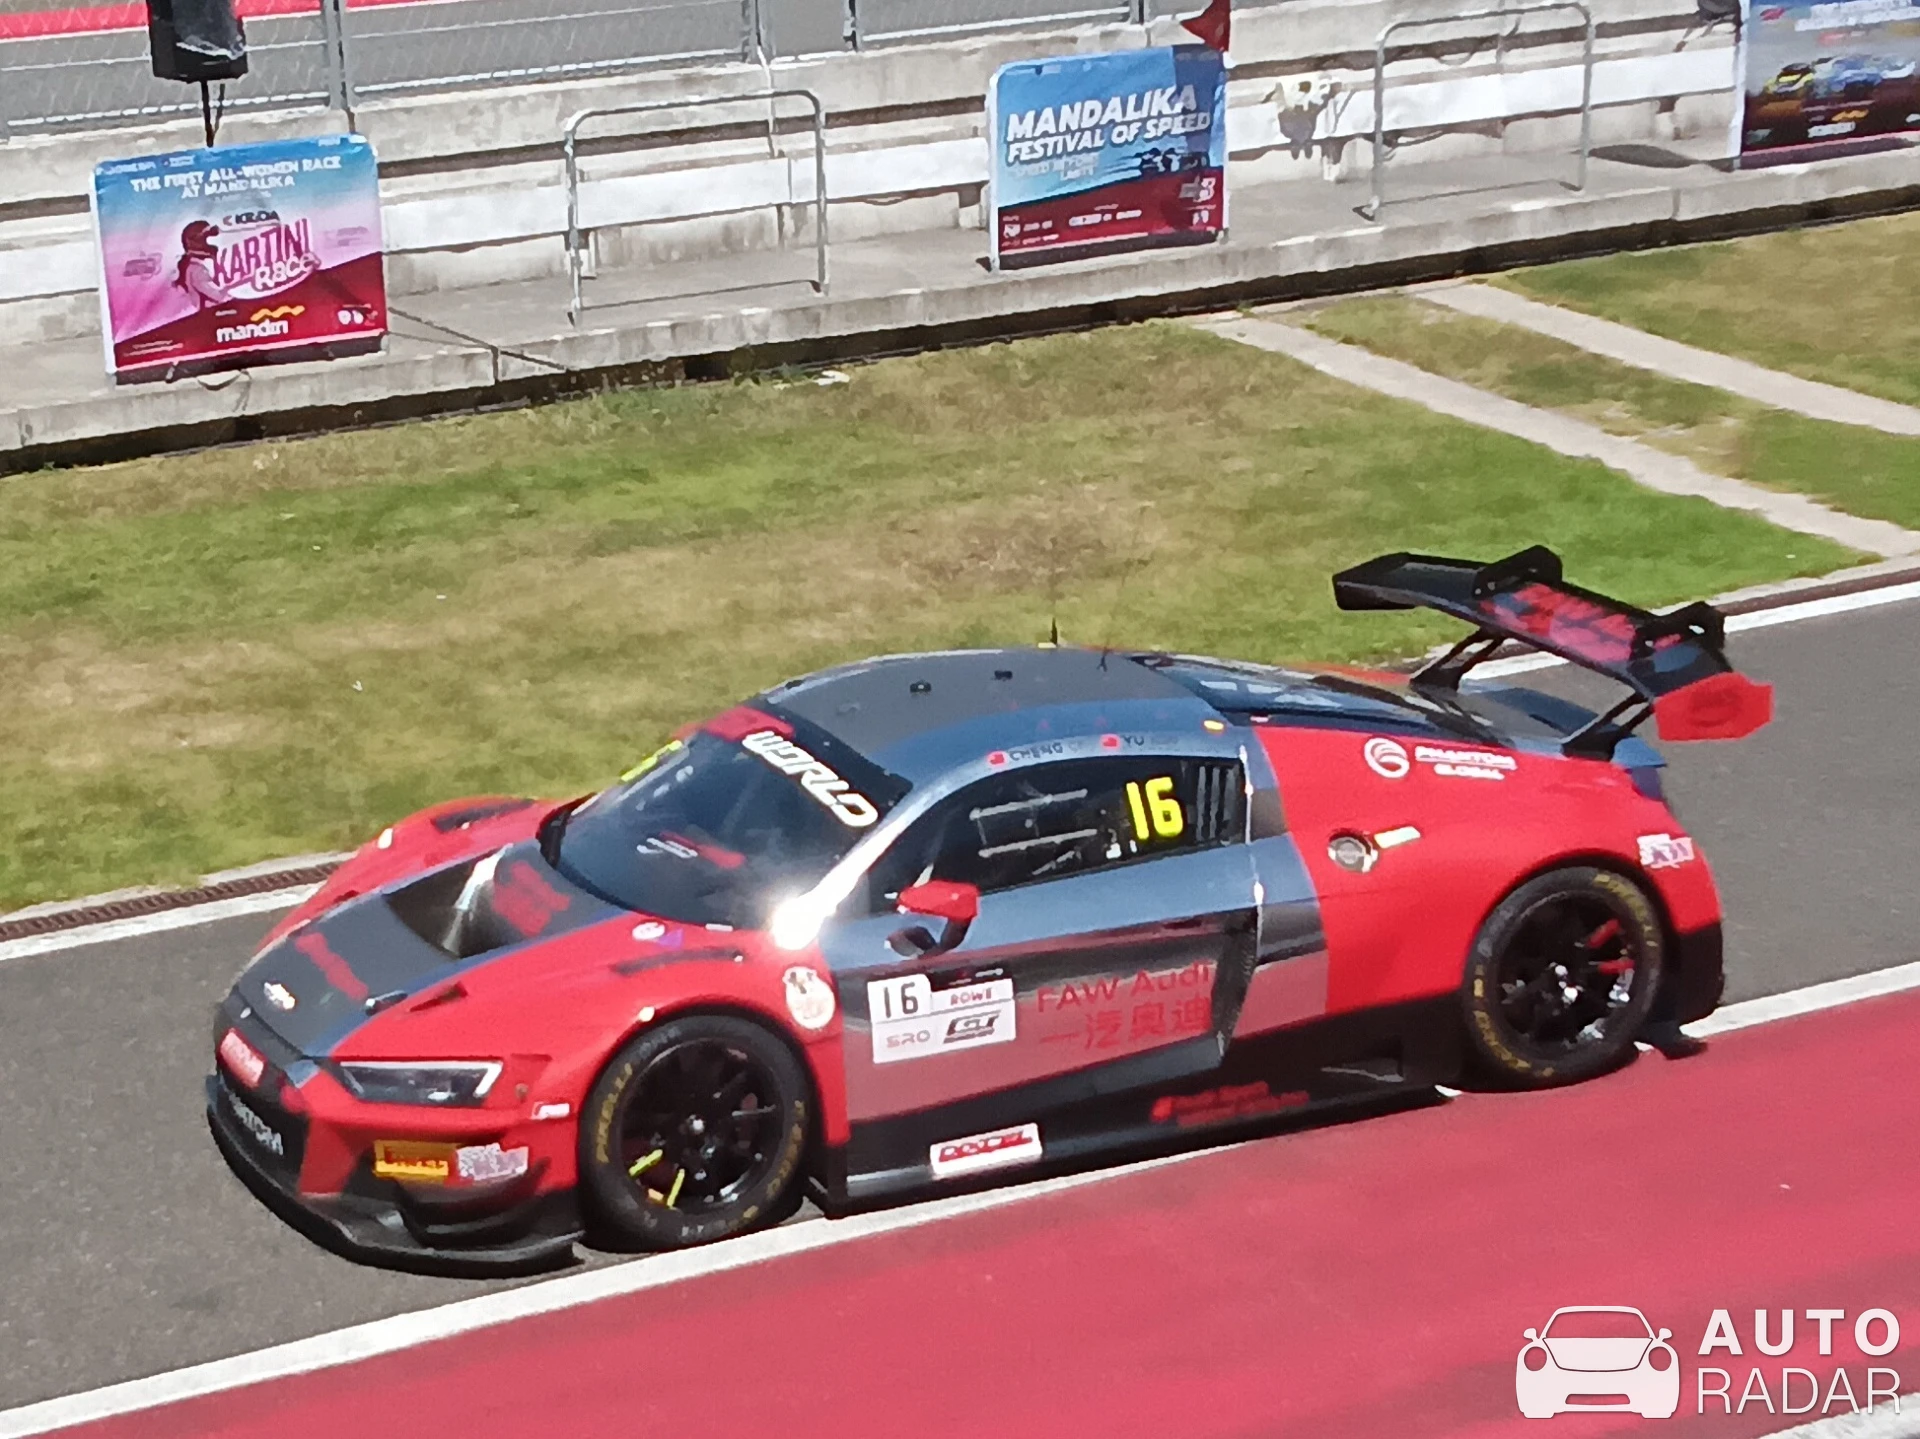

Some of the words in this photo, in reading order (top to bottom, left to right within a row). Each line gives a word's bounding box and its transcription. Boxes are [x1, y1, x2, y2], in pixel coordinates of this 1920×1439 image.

[1007, 84, 1197, 142] MANDALIKA
[1008, 129, 1105, 163] FESTIVAL
[1111, 122, 1141, 145] OF
[1144, 112, 1211, 138] SPEED
[130, 176, 162, 193] THE
[163, 170, 204, 189] FIRST
[207, 159, 300, 184] ALL-WOMEN
[302, 155, 343, 172] RACE
[181, 184, 201, 200] AT
[211, 218, 312, 287] KARTINI
[1122, 735, 1145, 747] YU
[741, 730, 879, 828] WORLD
[1126, 776, 1184, 841] 16
[883, 981, 919, 1019] 16
[950, 987, 994, 1006] ROWE
[1036, 975, 1119, 1013] FAW
[1131, 959, 1210, 997] Audi
[886, 1029, 931, 1049] SRO
[1039, 995, 1213, 1051] 一汽奥迪
